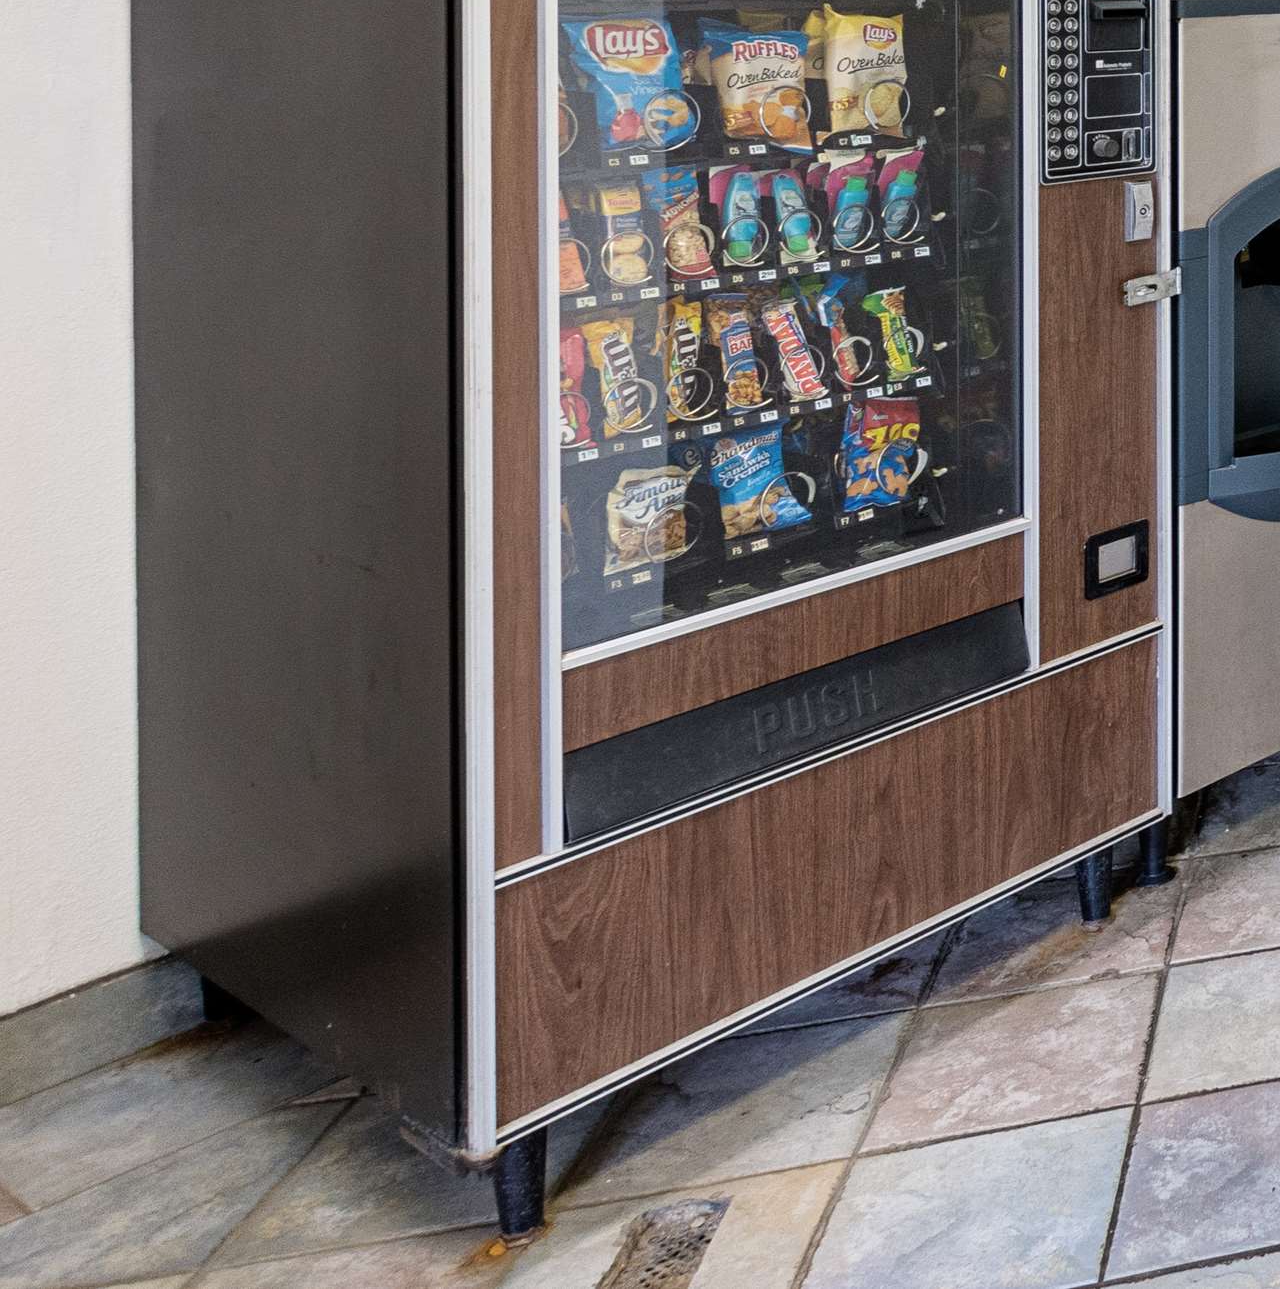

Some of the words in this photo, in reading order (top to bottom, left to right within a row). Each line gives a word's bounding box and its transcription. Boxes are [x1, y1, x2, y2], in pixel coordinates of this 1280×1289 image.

[733, 41, 799, 62] RUFFLES
[876, 50, 904, 66] Bake
[768, 313, 825, 395] PAYDAY
[718, 451, 769, 481] Sandwich
[722, 459, 770, 489] Cremes
[752, 670, 878, 754] PUSH
